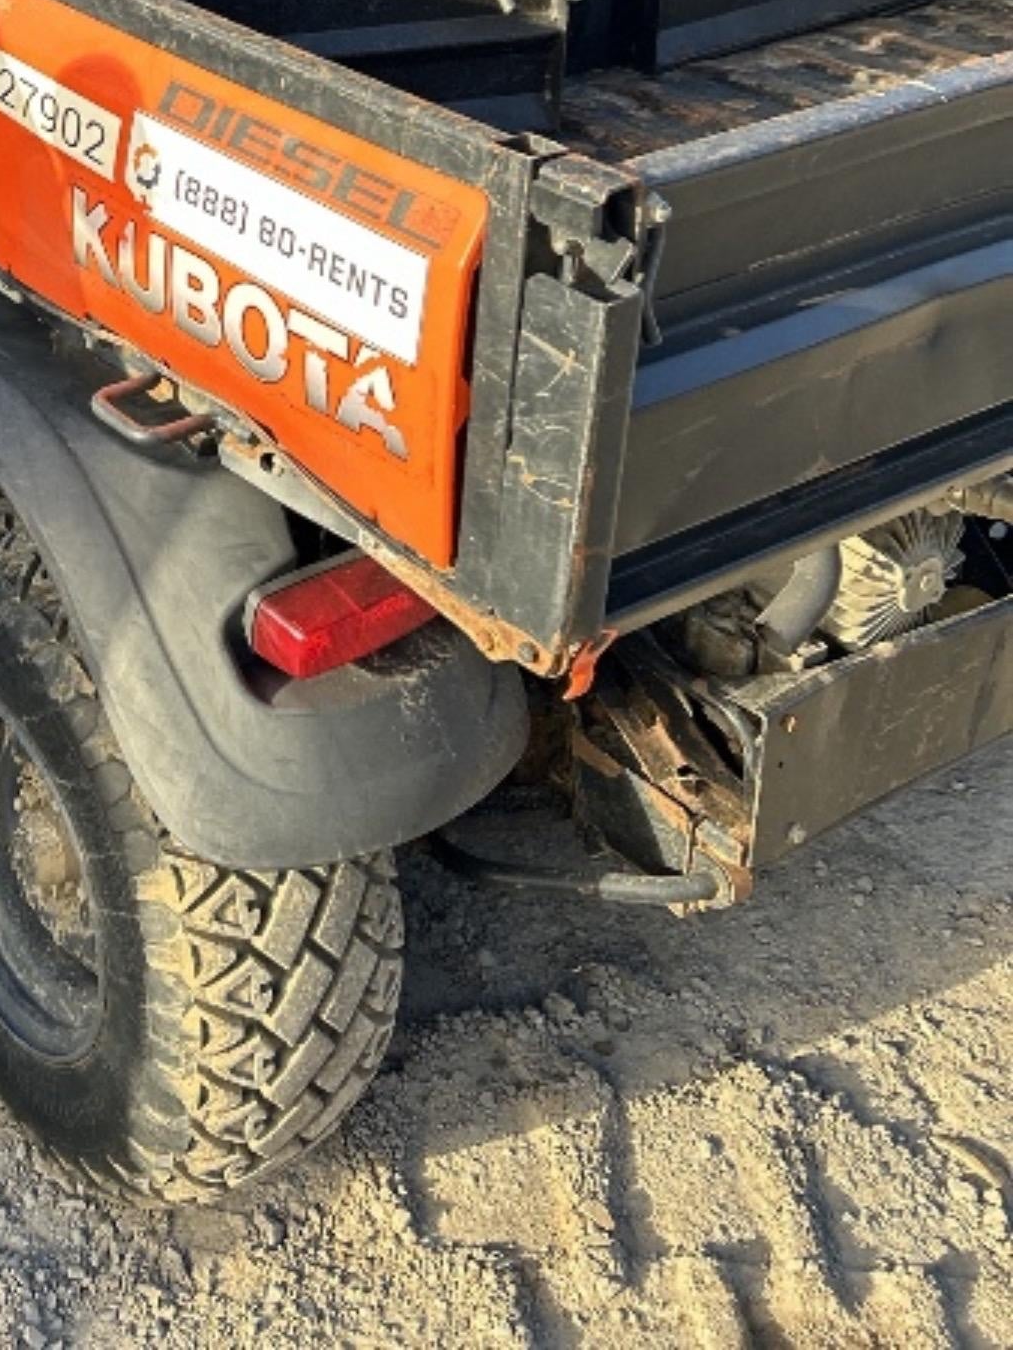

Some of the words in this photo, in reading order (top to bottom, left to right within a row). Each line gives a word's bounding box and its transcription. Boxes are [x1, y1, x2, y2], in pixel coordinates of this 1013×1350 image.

[156, 81, 442, 251] DIESEL
[174, 169, 250, 235] (888)
[259, 214, 410, 320] 80-RENTS
[71, 184, 409, 462] KUBOTA
